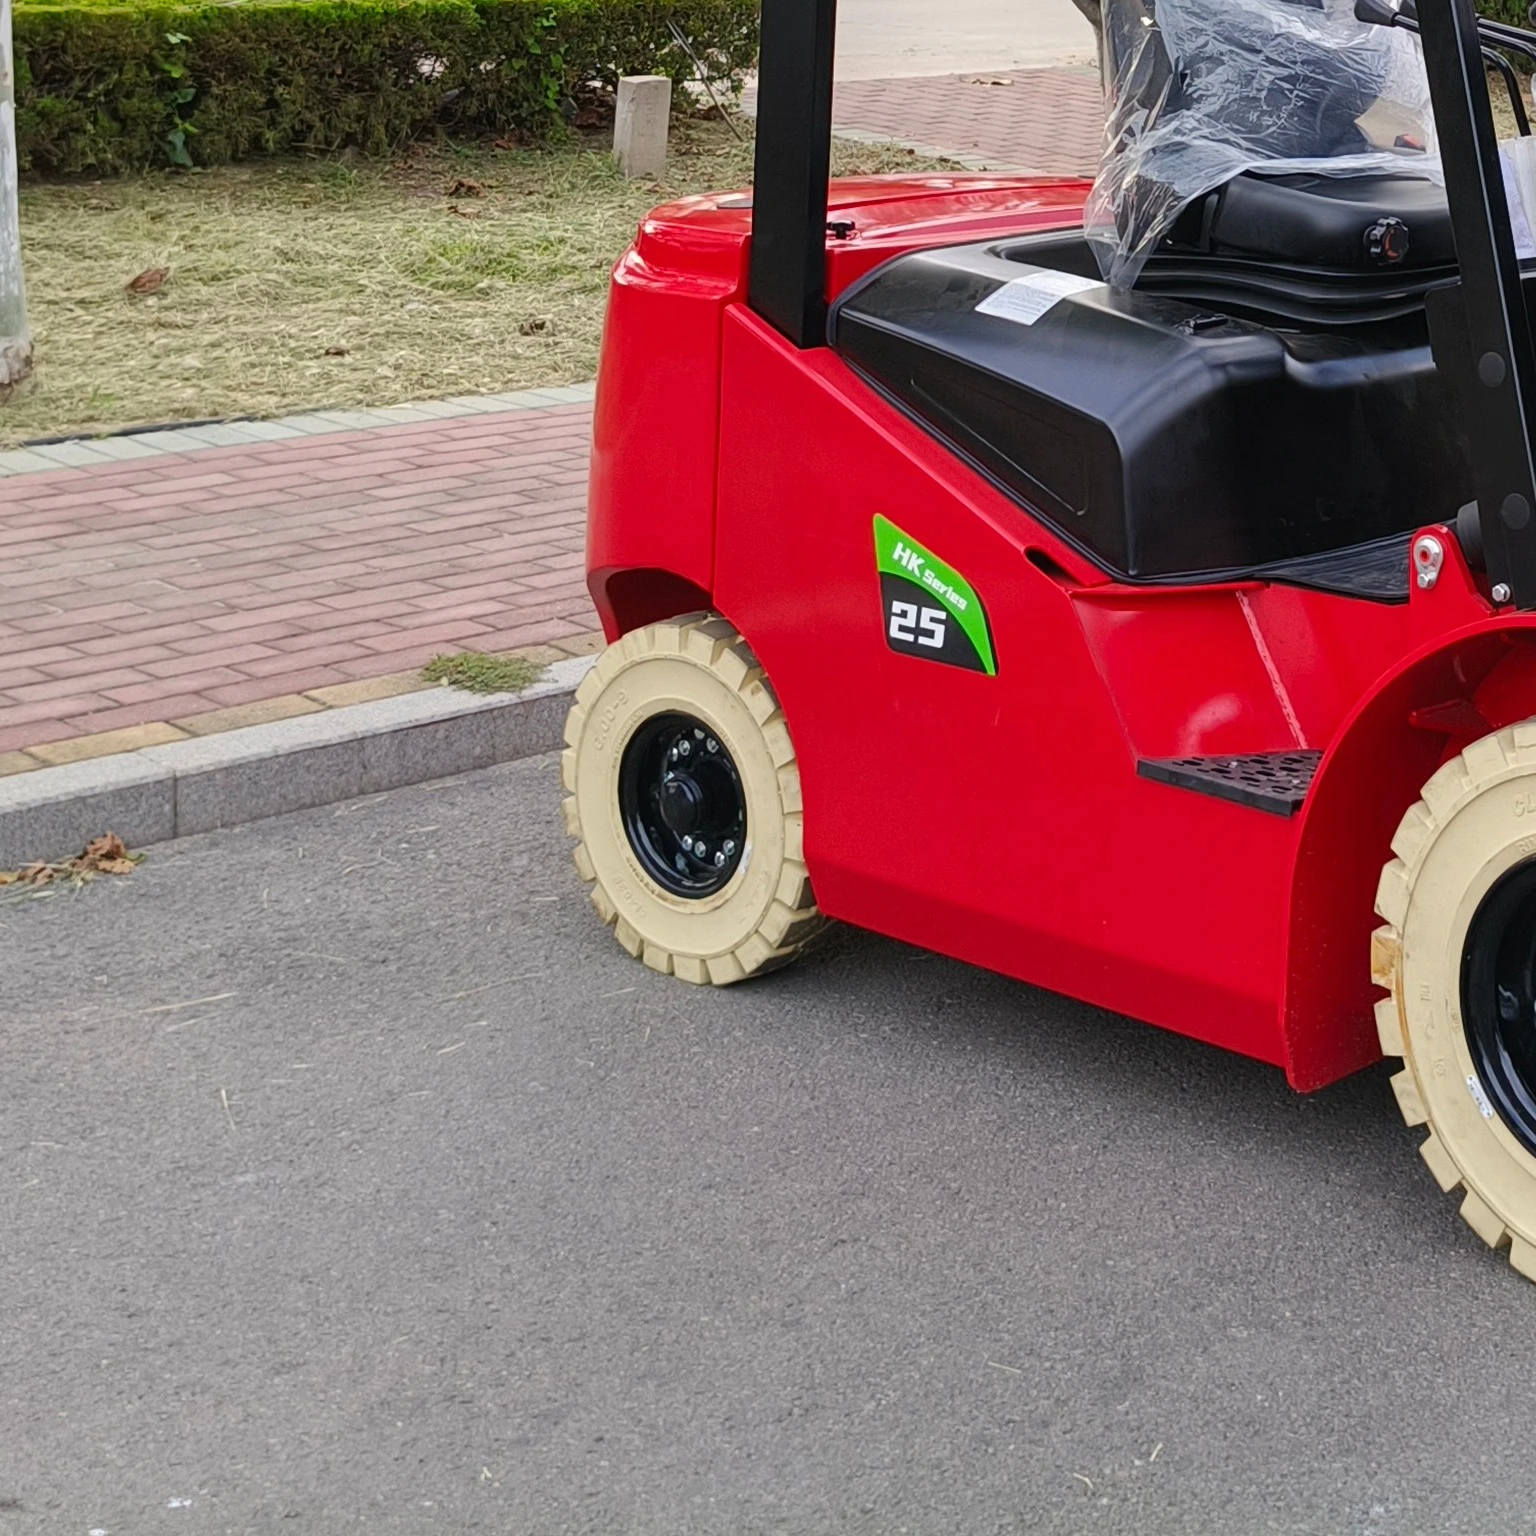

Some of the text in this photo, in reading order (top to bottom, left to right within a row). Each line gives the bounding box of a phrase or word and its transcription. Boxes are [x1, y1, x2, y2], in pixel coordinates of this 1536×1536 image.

[892, 541, 968, 611] HK Series
[889, 600, 947, 649] 25
